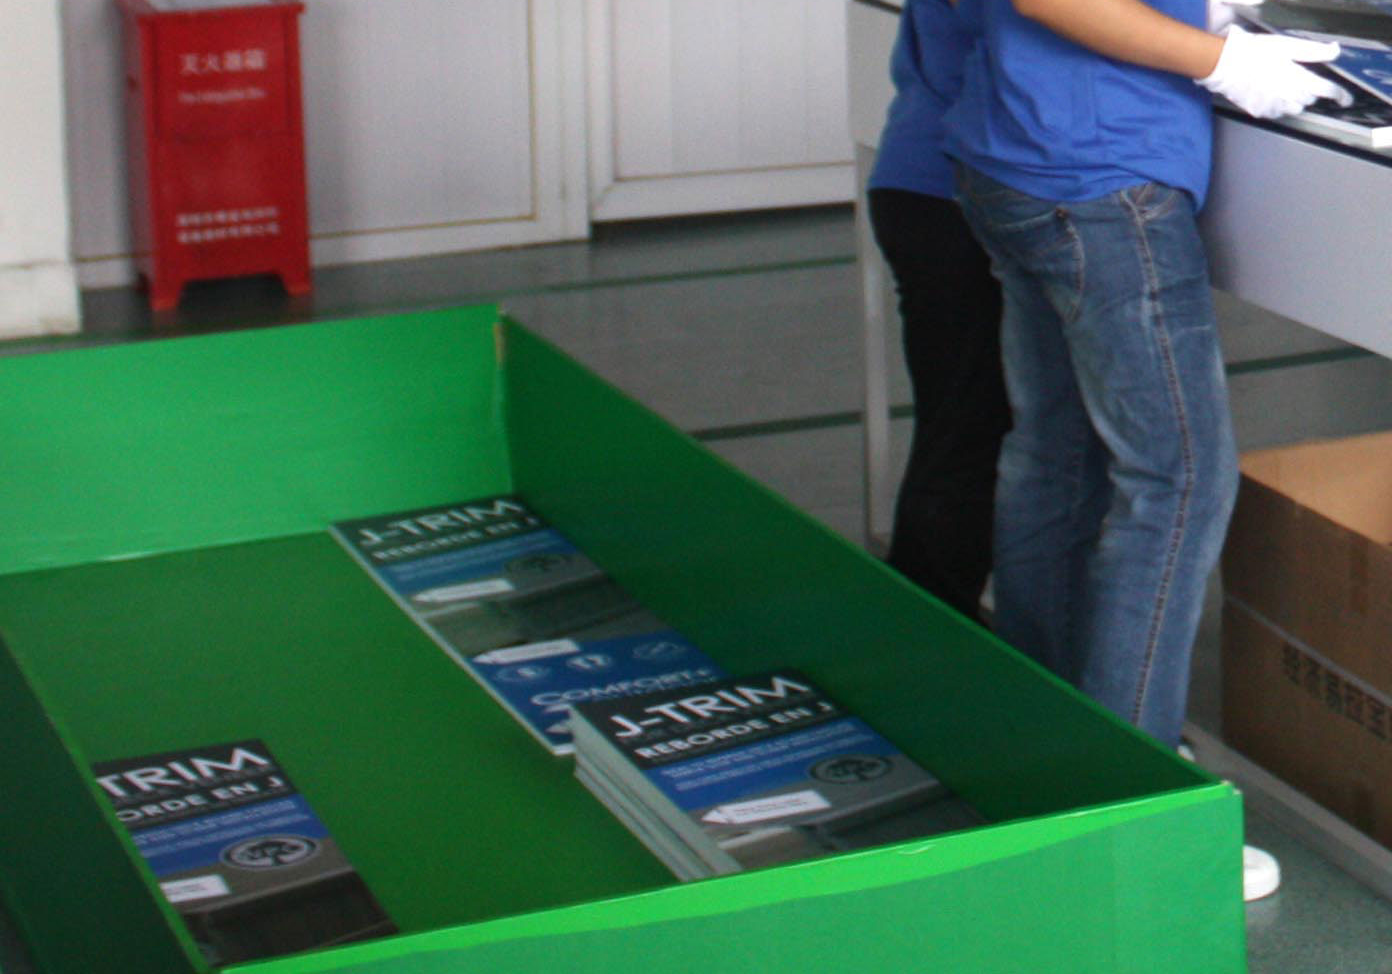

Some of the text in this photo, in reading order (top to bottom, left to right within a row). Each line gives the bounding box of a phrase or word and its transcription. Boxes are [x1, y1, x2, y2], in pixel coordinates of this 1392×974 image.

[359, 500, 523, 546] J-TRIM
[608, 676, 811, 738] J-TRIM
[634, 719, 769, 760] REBORDE
[769, 708, 813, 724] EN
[213, 783, 257, 801] EN
